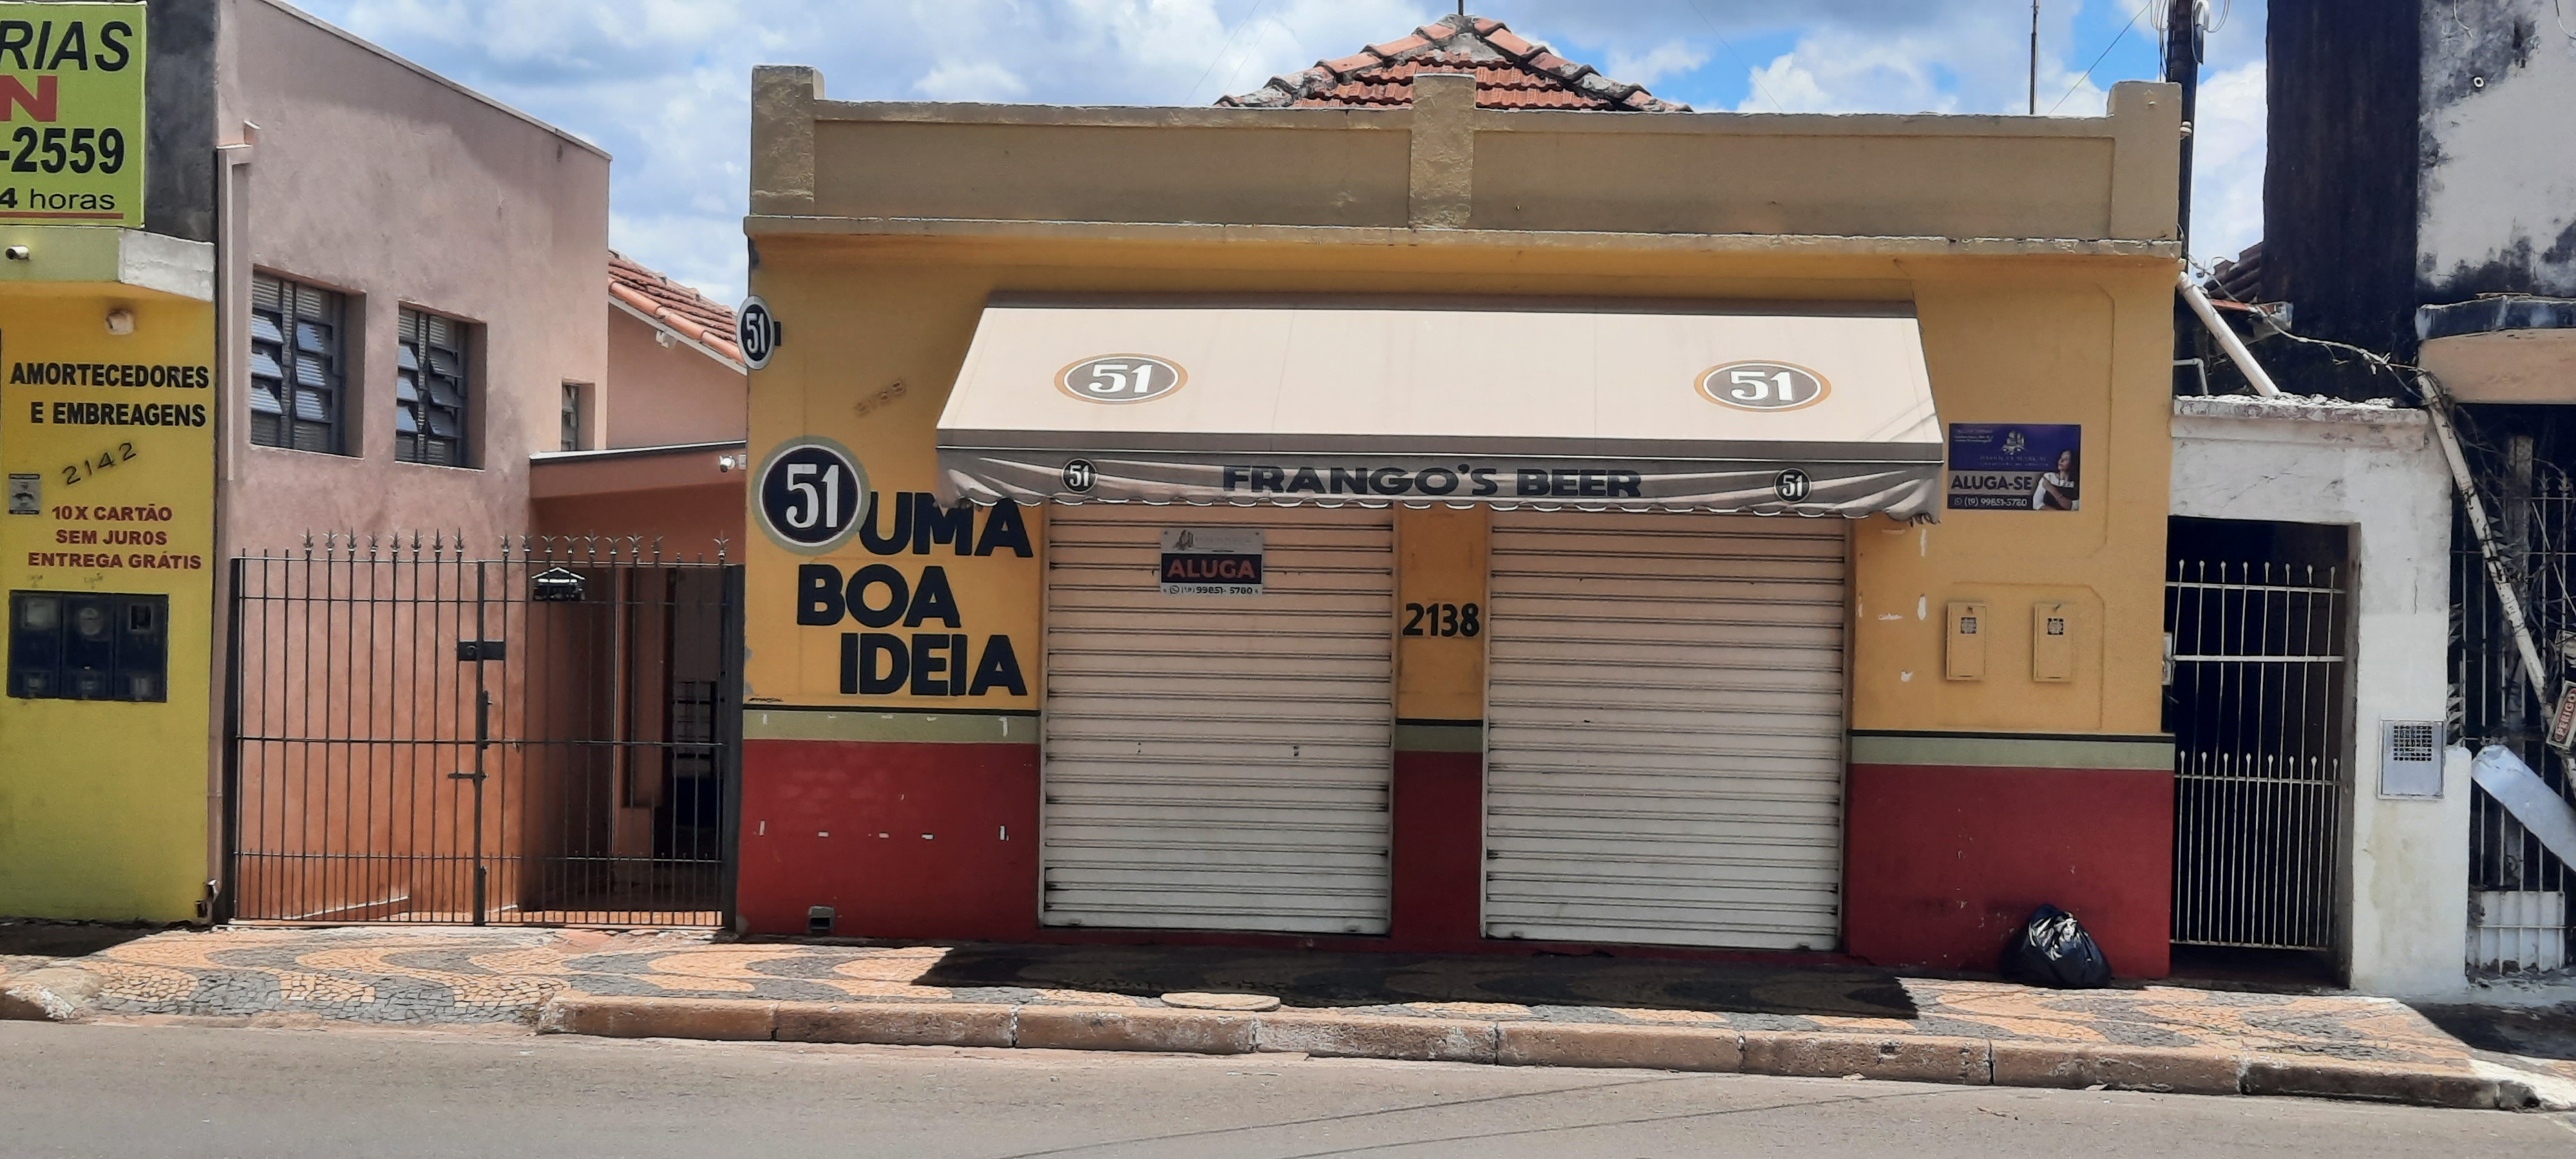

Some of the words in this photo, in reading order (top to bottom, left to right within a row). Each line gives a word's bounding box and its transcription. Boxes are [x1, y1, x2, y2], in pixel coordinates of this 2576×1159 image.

[0, 21, 133, 71] RIAS
[30, 189, 115, 210] horas
[746, 312, 766, 354] 51
[10, 363, 209, 388] AMORTECEDORES
[1088, 364, 1153, 393] 51
[1730, 371, 1794, 401] 51
[31, 402, 43, 423] E
[53, 402, 206, 427] EMBREAGENS
[62, 442, 136, 485] 2142
[1069, 464, 1090, 487] 51
[1224, 464, 1498, 496] FRANGO'S
[1516, 469, 1641, 497] BEER
[1782, 475, 1803, 496] 51
[1951, 475, 2032, 491] ALUGA-SE
[786, 463, 840, 529] 51
[1964, 497, 1978, 507] (19)
[93, 503, 173, 522] CARTÃO
[859, 491, 1033, 558] UMA
[55, 529, 97, 544] SEM
[28, 552, 122, 568] ENTREGA
[129, 551, 202, 569] GRÁTIS
[1166, 559, 1255, 579] ALUGA
[797, 563, 961, 628] BOA
[1403, 603, 1480, 637] 2138
[840, 632, 1028, 696] IDEIA
